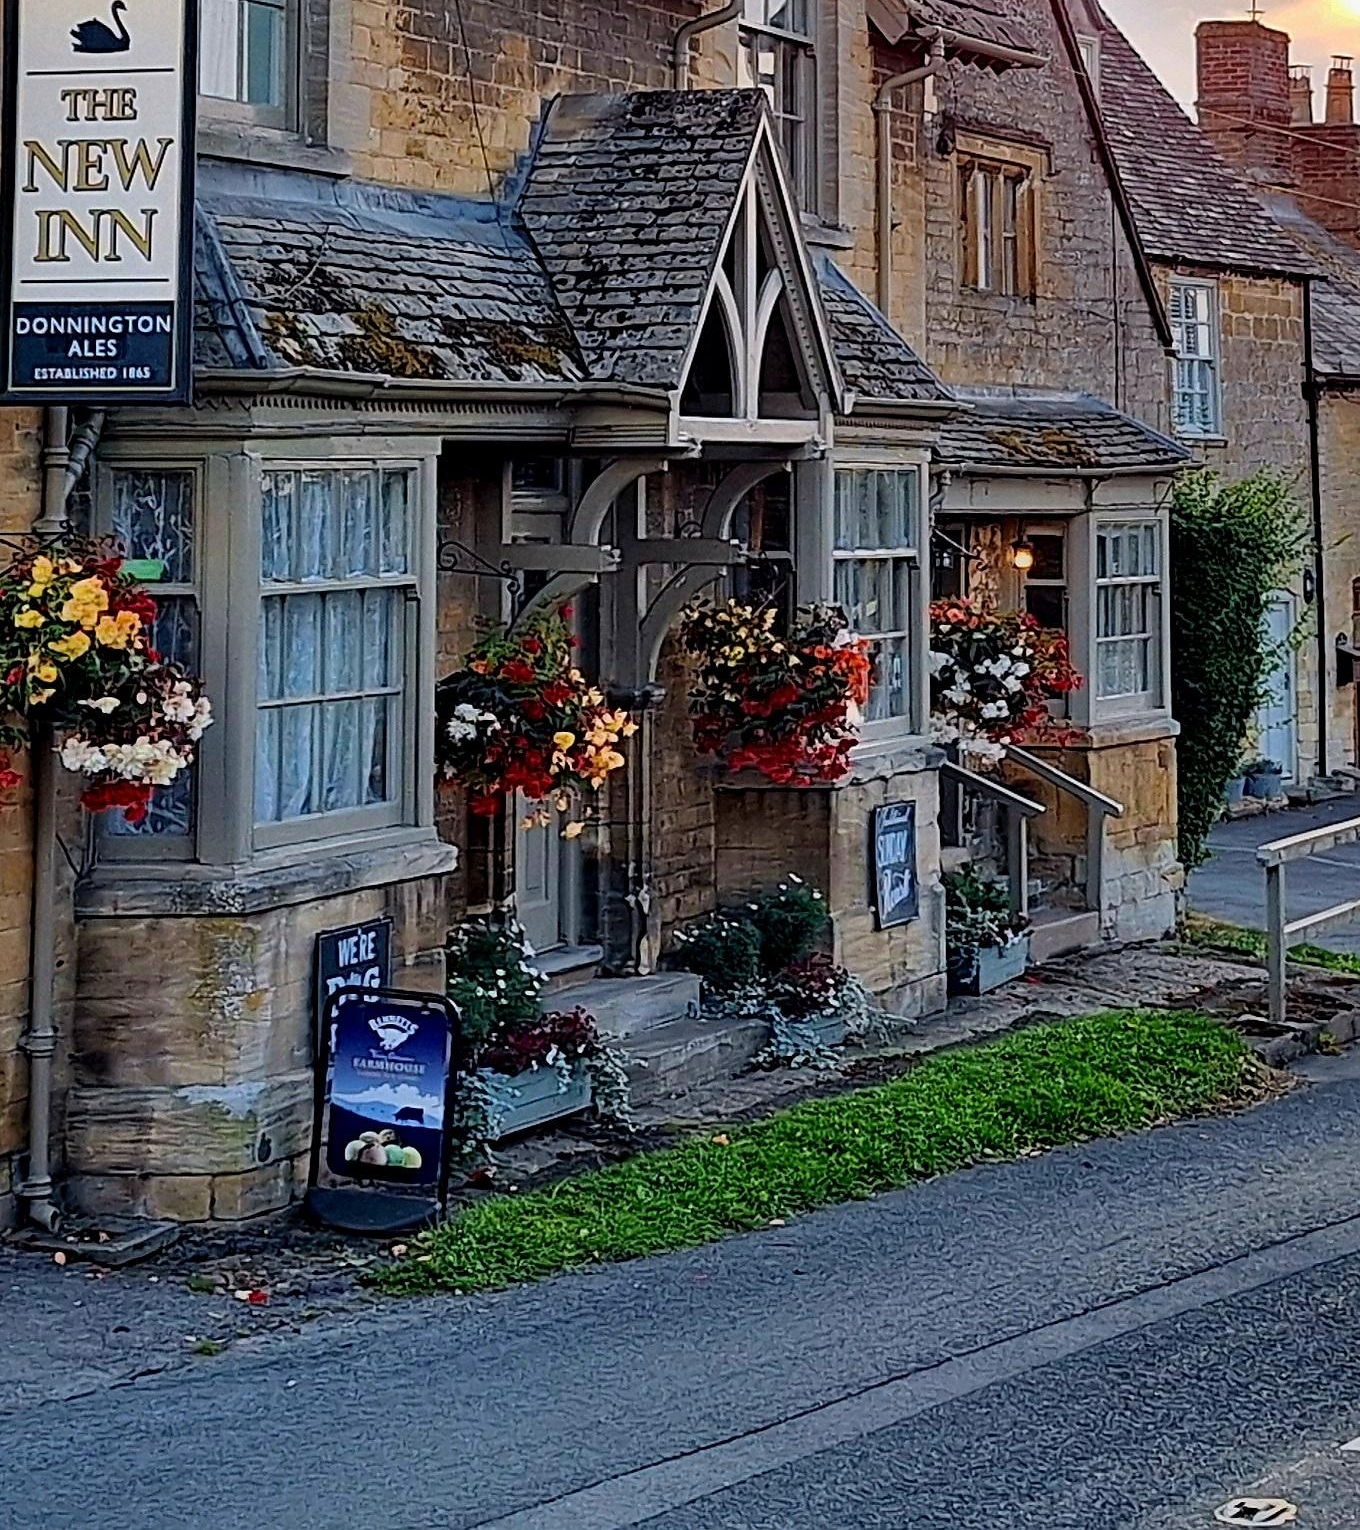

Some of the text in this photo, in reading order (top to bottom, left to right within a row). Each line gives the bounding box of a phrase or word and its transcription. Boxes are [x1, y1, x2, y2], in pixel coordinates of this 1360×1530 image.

[61, 88, 137, 122] THE
[22, 137, 174, 193] NEW
[33, 208, 158, 263] INN
[16, 315, 171, 334] DONNINGTON
[67, 339, 118, 357] ALES
[34, 367, 117, 380] ESTABLISHED
